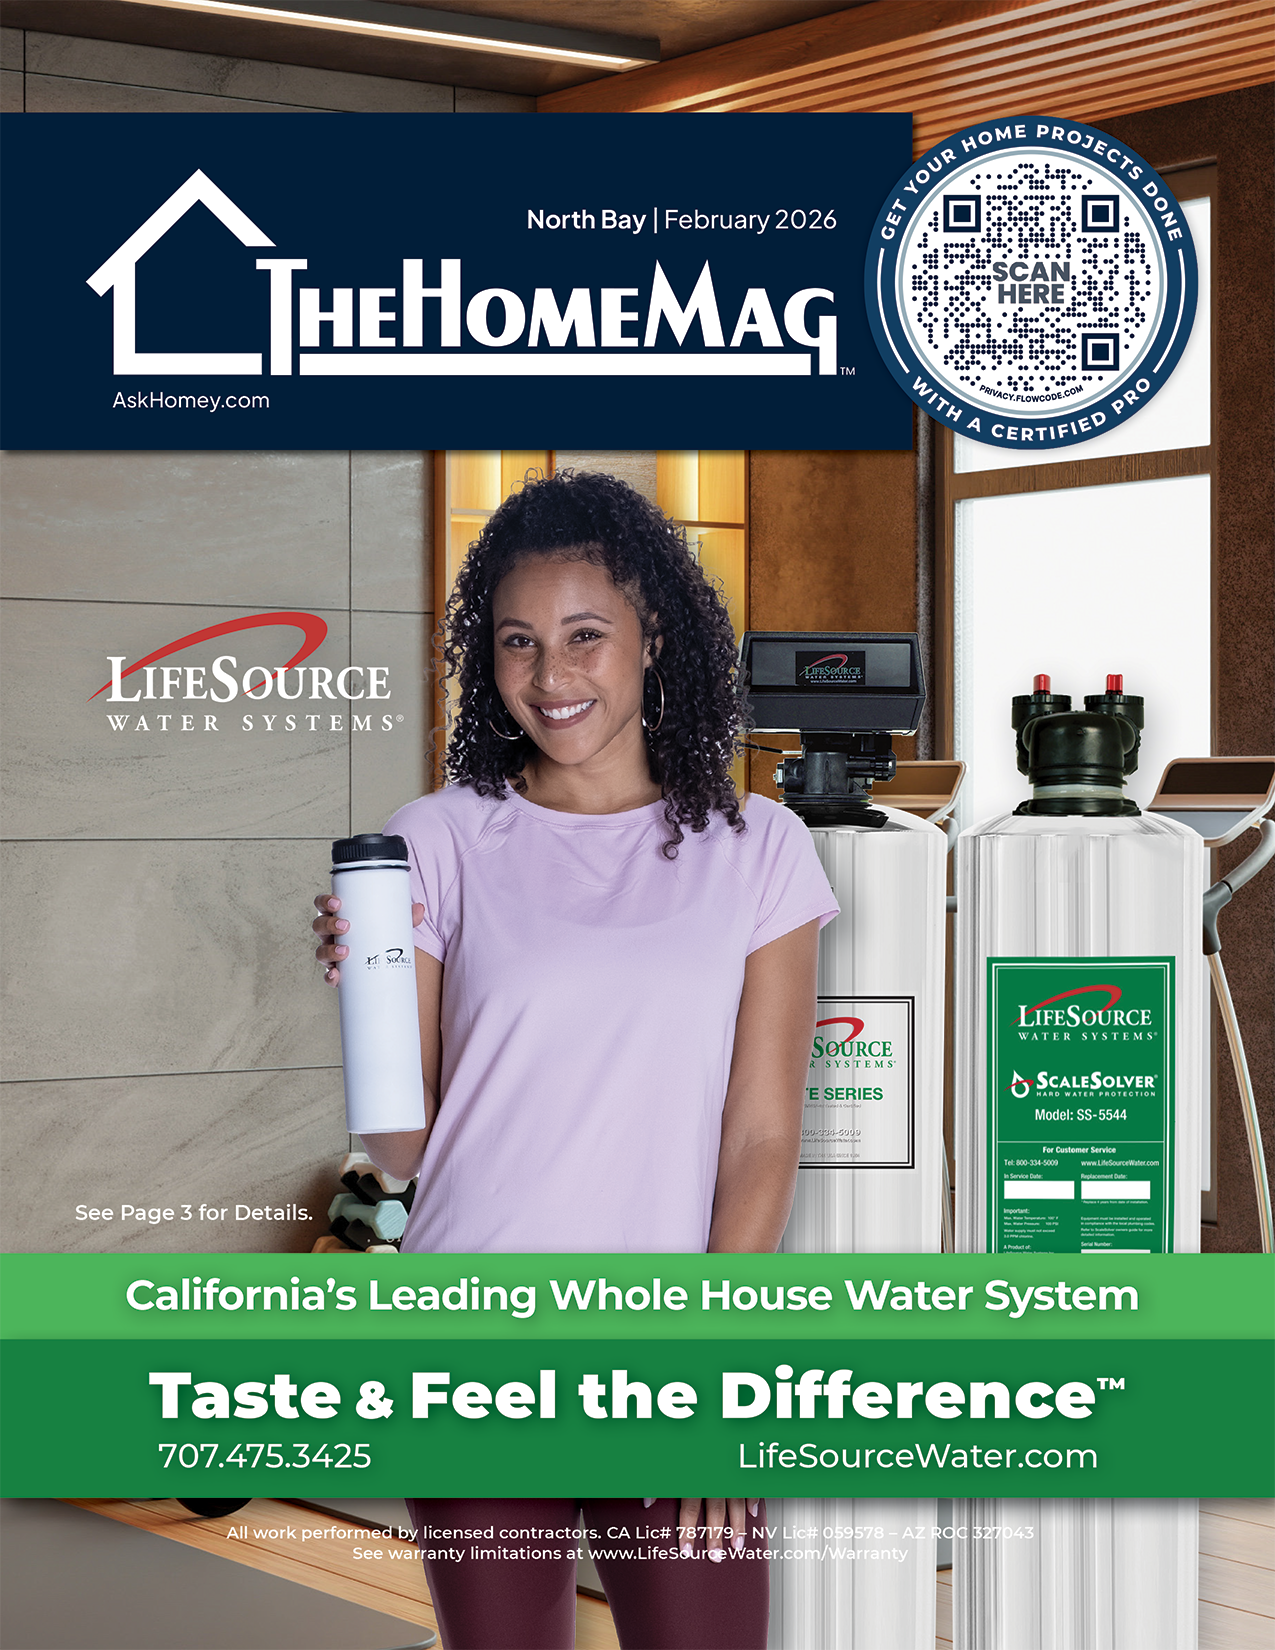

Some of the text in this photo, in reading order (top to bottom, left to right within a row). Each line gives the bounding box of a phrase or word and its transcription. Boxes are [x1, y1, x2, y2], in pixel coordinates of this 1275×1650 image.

[1019, 1032, 1070, 1040] WATER
[824, 1087, 884, 1101] SERIES
[1035, 1109, 1127, 1121] Model: SS-5544
[1043, 1146, 1054, 1154] For
[1056, 1146, 1089, 1154] Customer
[1004, 1159, 1058, 1167] Tel: 800-334-5009
[1081, 1159, 1159, 1167] www.LifeSourceWater.com
